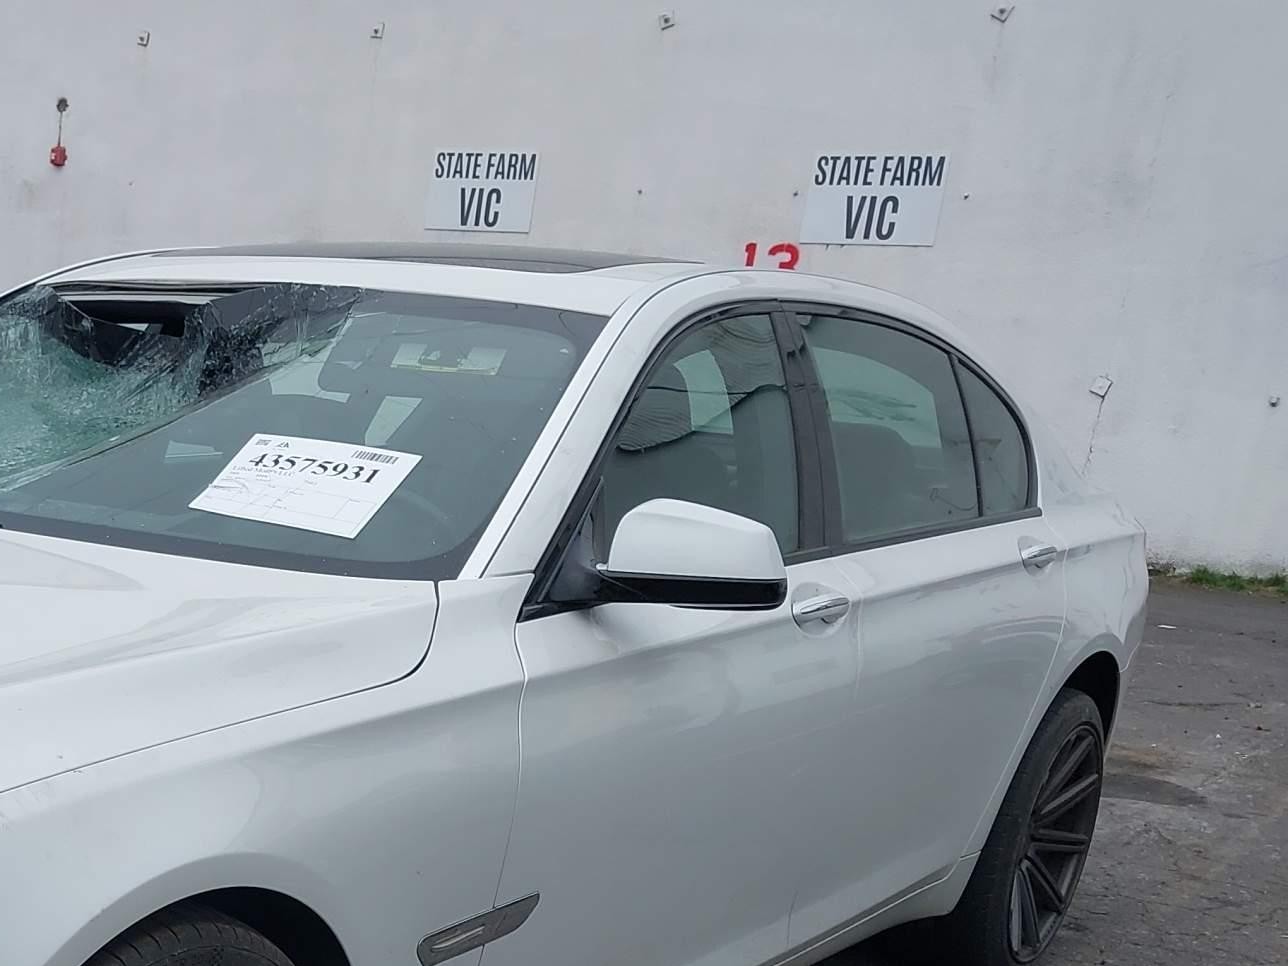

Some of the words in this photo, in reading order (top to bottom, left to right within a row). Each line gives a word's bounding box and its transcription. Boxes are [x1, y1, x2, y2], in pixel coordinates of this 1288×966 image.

[435, 152, 483, 179] STATE
[485, 153, 537, 180] FARM
[814, 155, 877, 186] STATE
[879, 155, 946, 187] FARM
[460, 187, 502, 228] VIC
[845, 195, 899, 241] VIC
[249, 453, 381, 484] 43575931
